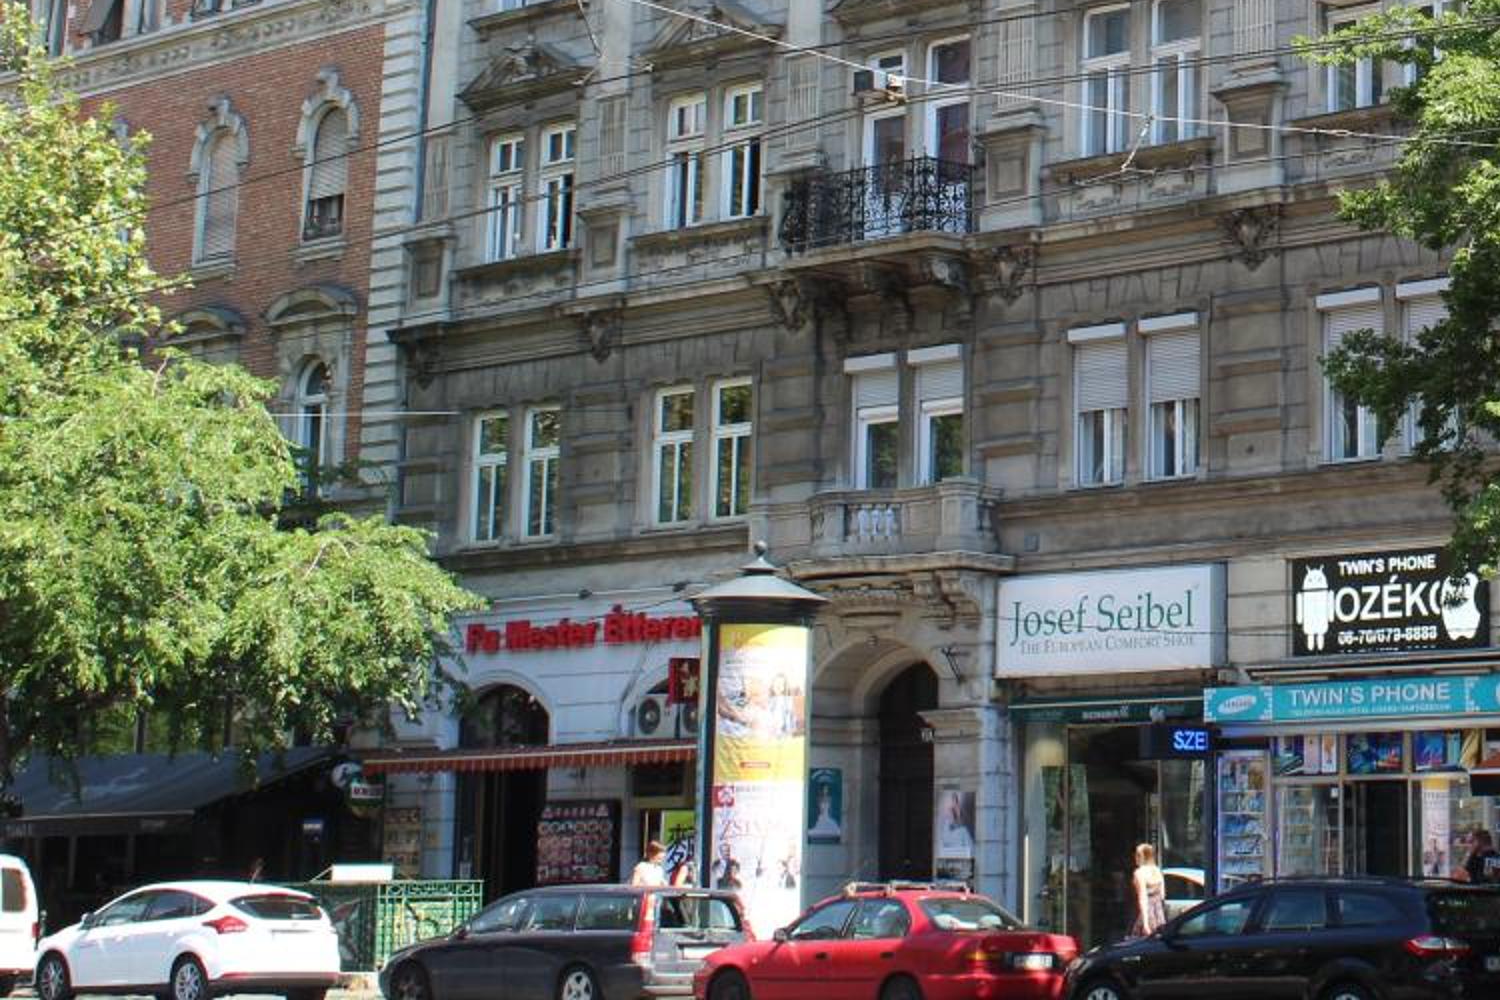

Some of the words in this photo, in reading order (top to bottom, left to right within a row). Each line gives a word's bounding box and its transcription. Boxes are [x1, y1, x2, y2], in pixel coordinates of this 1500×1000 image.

[1337, 558, 1385, 577] TWIN'S
[1388, 553, 1437, 572] PHONE
[1010, 595, 1089, 647] Josef
[1097, 588, 1195, 633] Seibel
[1287, 687, 1365, 708] TWIN'S
[1370, 682, 1452, 703] PHONE
